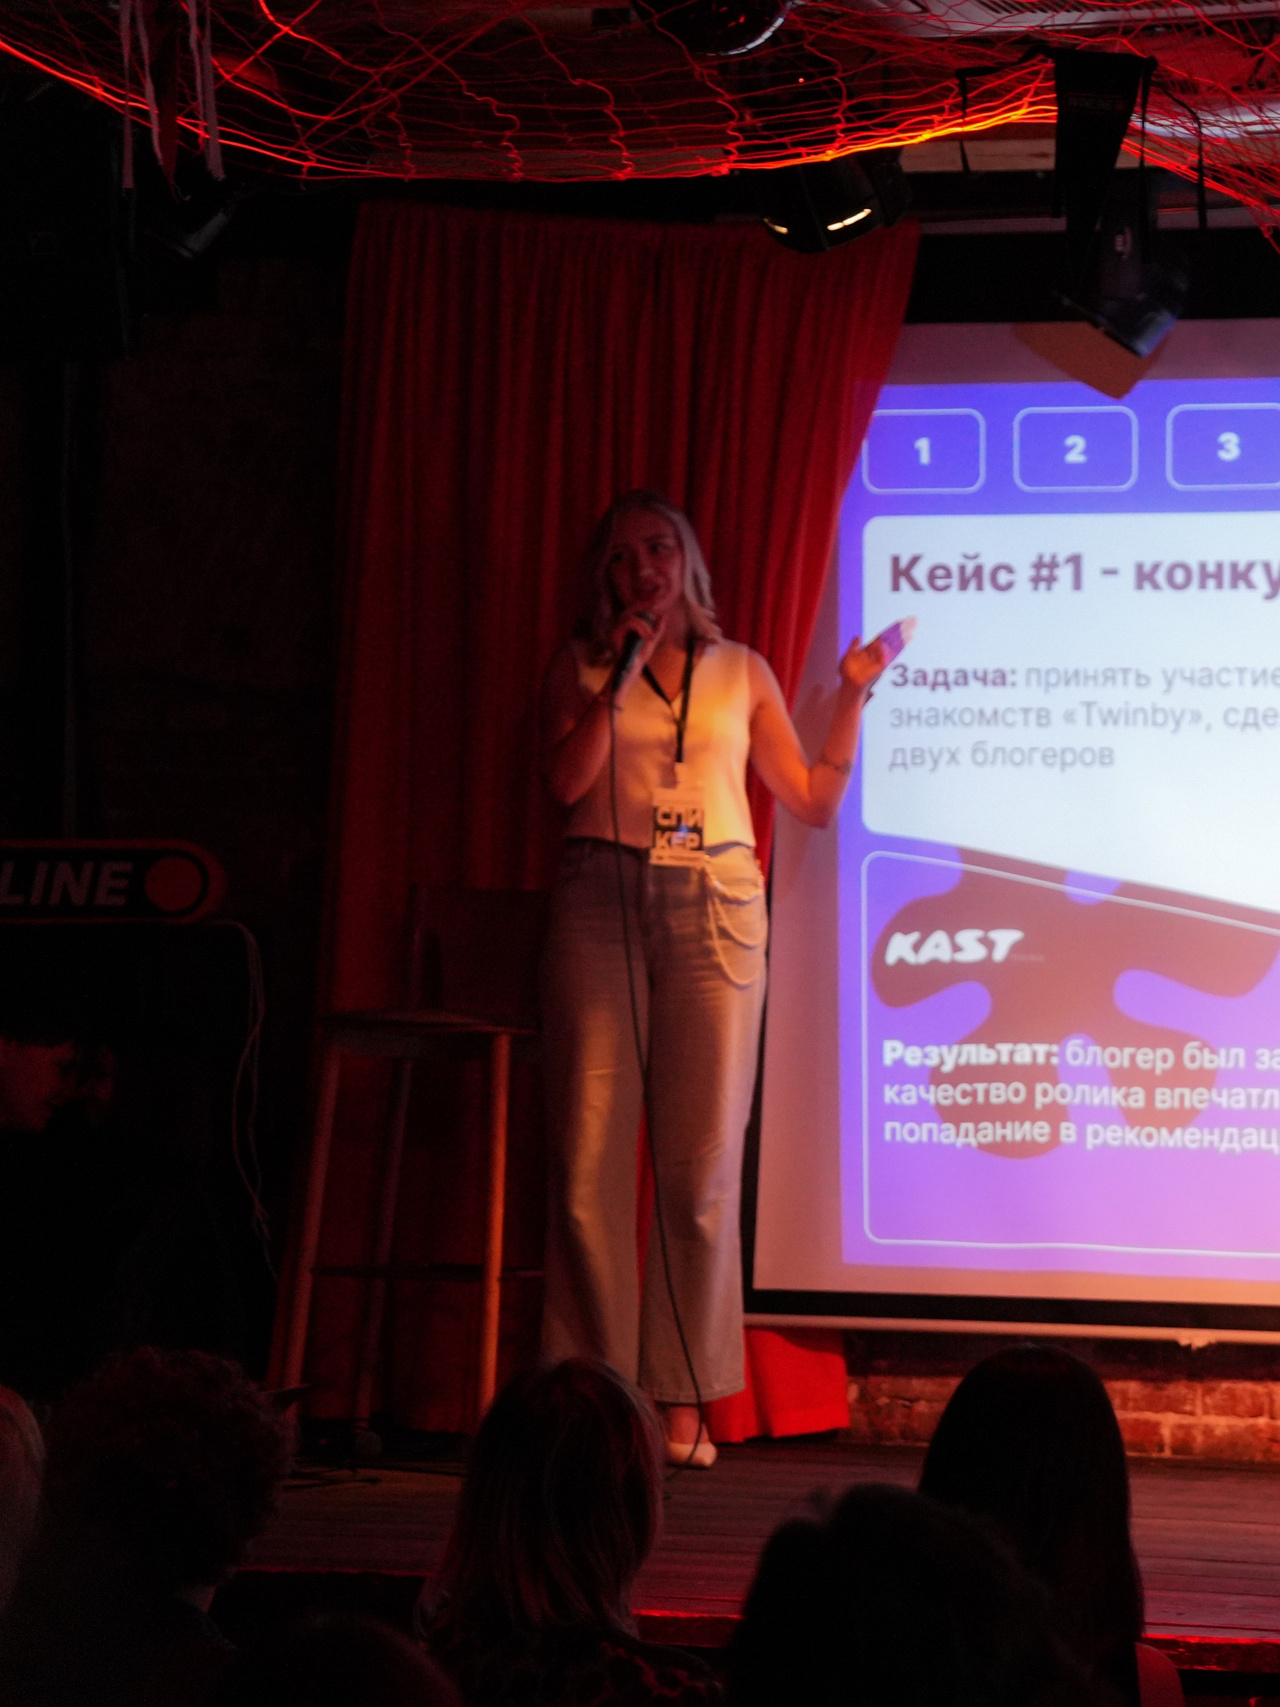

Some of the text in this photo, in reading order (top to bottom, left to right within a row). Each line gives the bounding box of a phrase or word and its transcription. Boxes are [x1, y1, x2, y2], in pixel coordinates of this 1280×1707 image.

[914, 437, 932, 465] 1
[1064, 436, 1087, 464] 2
[1217, 432, 1241, 462] 3
[890, 552, 1016, 593] Кейс
[1029, 553, 1084, 592] #1
[890, 662, 1017, 692] Задача:
[1024, 665, 1152, 696] принять
[889, 705, 1051, 728] знакомств
[1063, 700, 1213, 733] «Twinby»,
[888, 740, 1115, 772] двух блогеров
[884, 928, 1025, 966] KAST
[882, 1039, 1060, 1073] Результат:
[1065, 1039, 1175, 1075] блогер
[1182, 1040, 1246, 1071] был
[884, 1081, 1027, 1106] качество
[1034, 1081, 1146, 1110] ролика
[884, 1120, 1051, 1149] попадание
[1059, 1121, 1078, 1143] в
